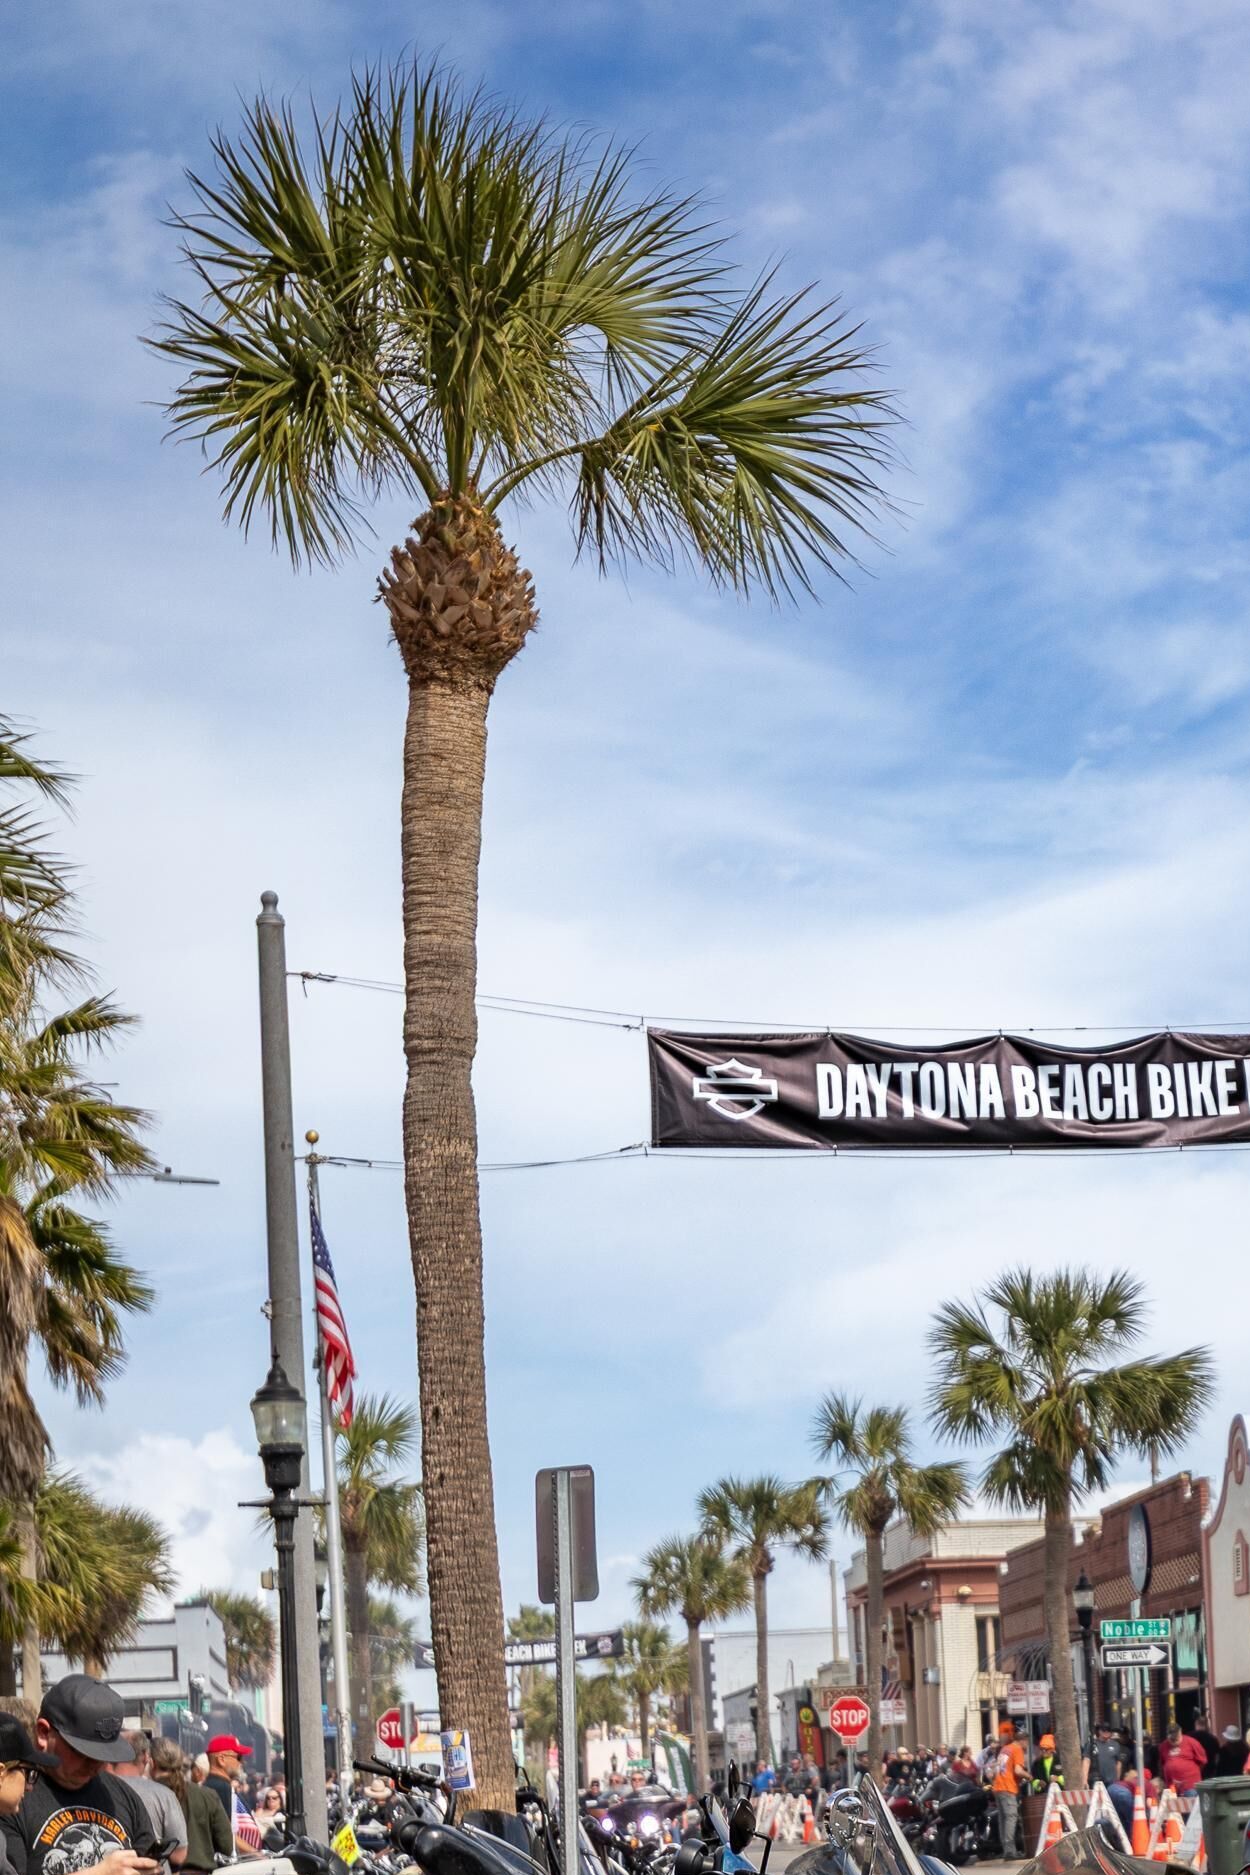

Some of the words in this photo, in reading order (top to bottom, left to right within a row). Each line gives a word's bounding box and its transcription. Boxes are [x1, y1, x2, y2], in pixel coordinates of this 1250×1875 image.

[816, 1061, 1002, 1120] DAYTONA
[1012, 1062, 1139, 1121] BEACH
[1146, 1060, 1241, 1119] BIKE
[1104, 1622, 1145, 1636] Noble
[1109, 1652, 1127, 1661] ONE
[1131, 1650, 1149, 1660] WAY
[832, 1709, 867, 1726] STOP
[380, 1721, 401, 1739] ST
